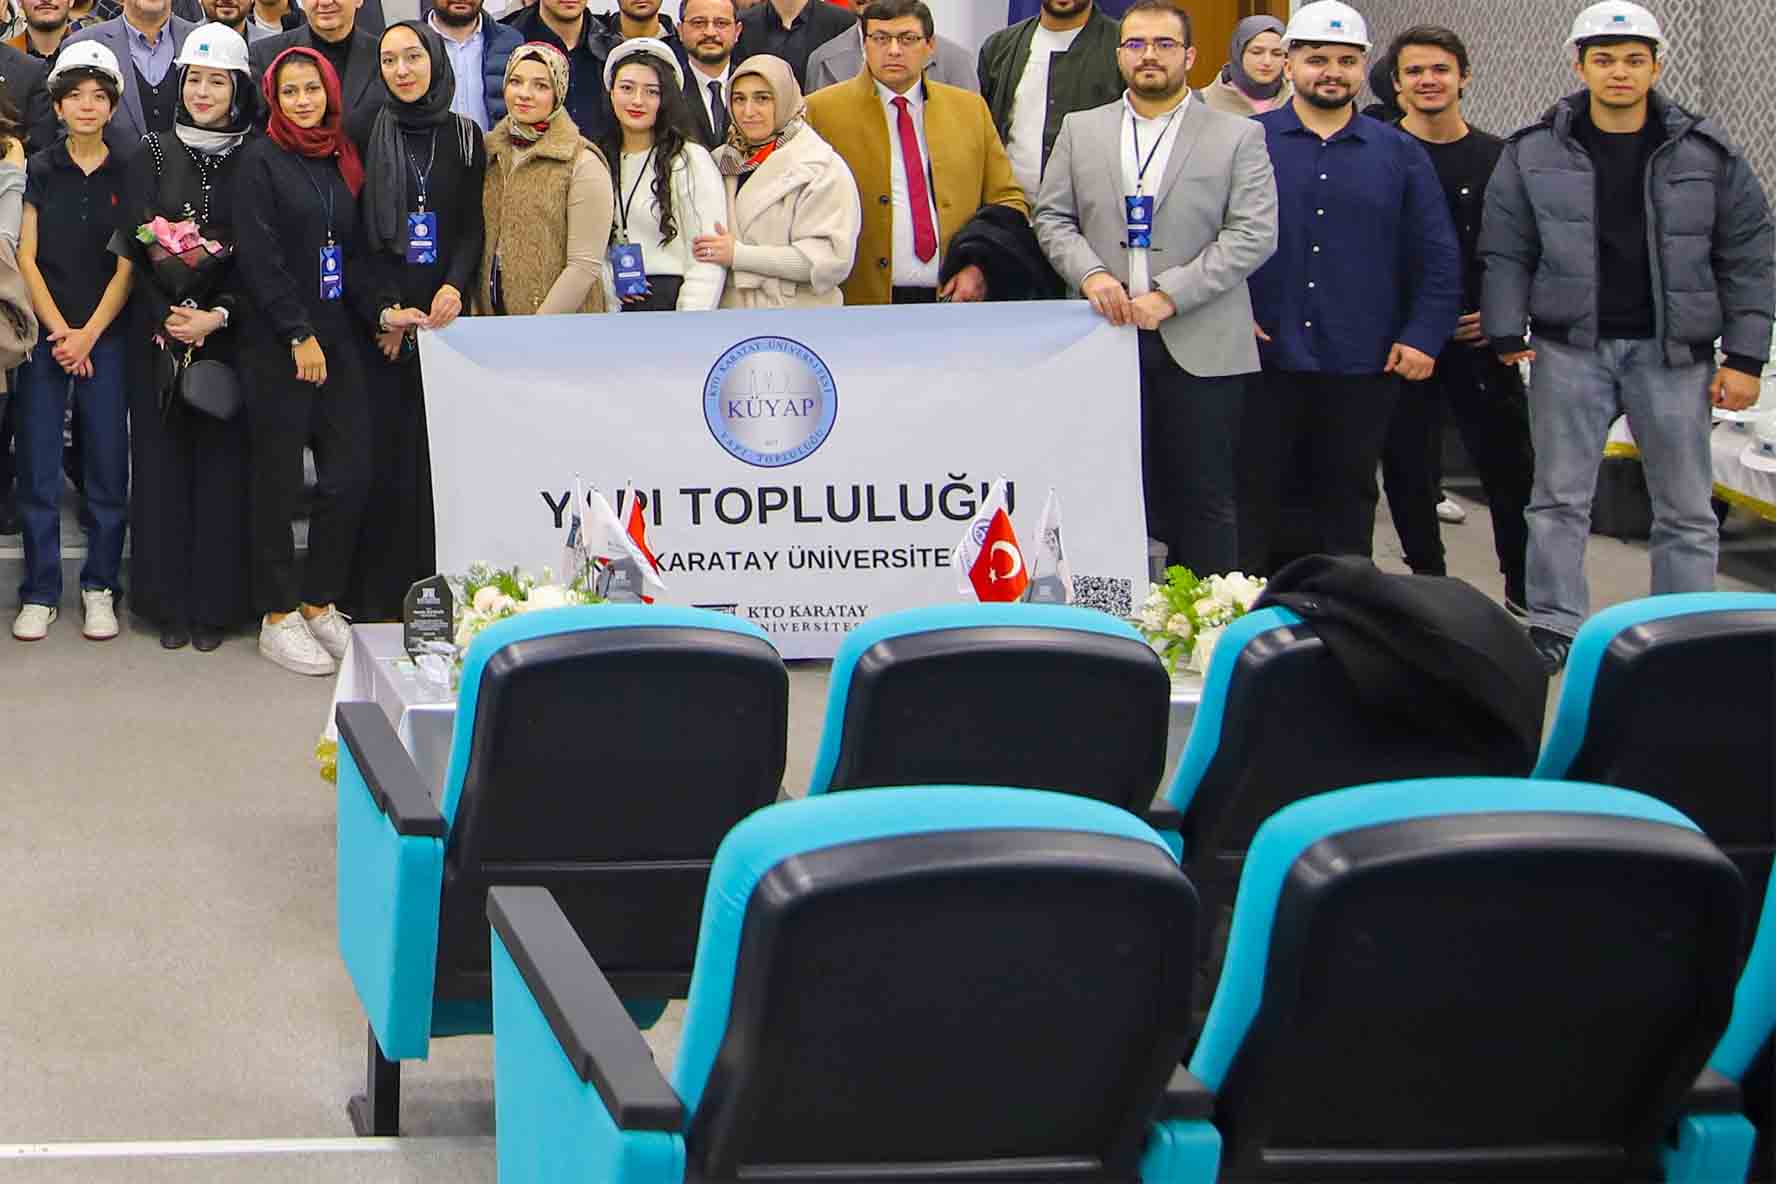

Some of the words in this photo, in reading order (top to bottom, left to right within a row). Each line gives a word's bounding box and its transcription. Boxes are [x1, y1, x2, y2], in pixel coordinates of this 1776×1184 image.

[727, 395, 815, 418] KÜYAP
[680, 472, 1016, 526] TOPLULUĞU
[788, 544, 957, 570] ÜNİVERSİTE
[748, 606, 785, 618] KTO
[790, 604, 869, 617] KARATAY
